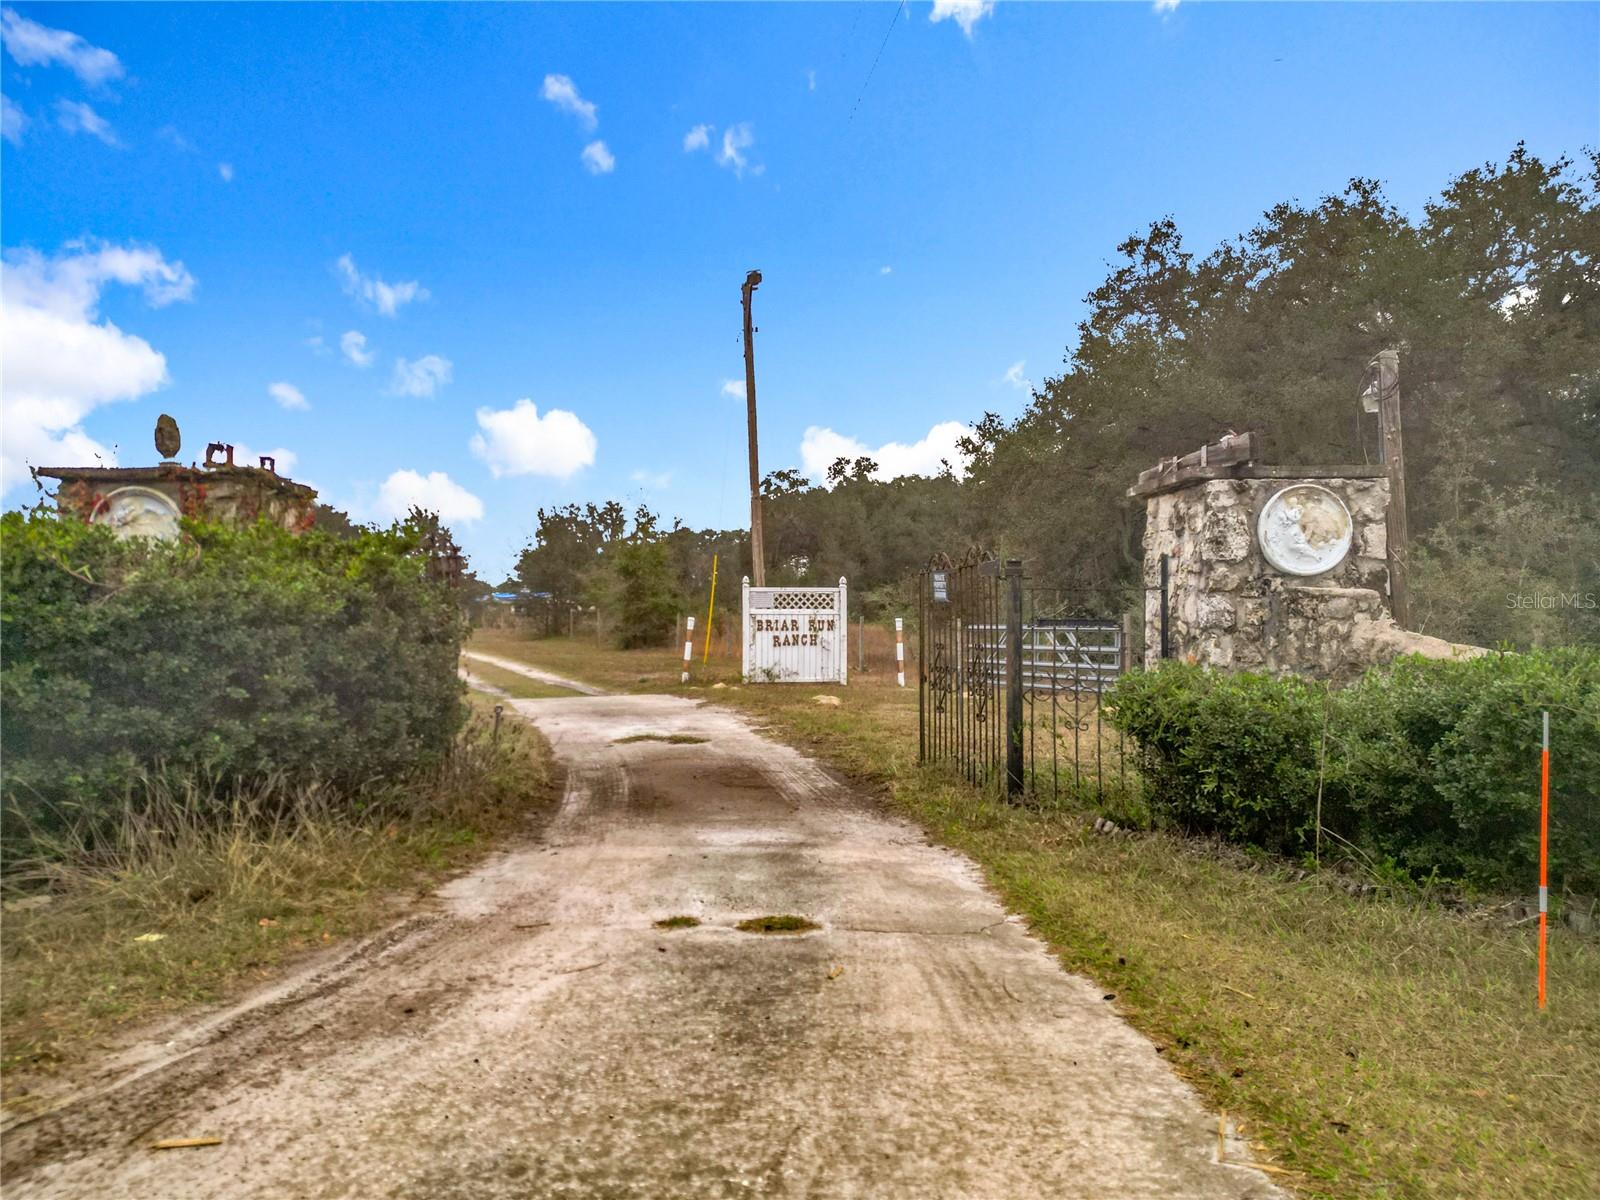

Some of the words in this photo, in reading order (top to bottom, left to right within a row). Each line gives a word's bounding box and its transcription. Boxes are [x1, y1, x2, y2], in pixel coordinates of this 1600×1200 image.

[757, 619, 799, 631] BRIAR
[808, 619, 835, 631] RUN
[773, 634, 817, 647] RANCH
